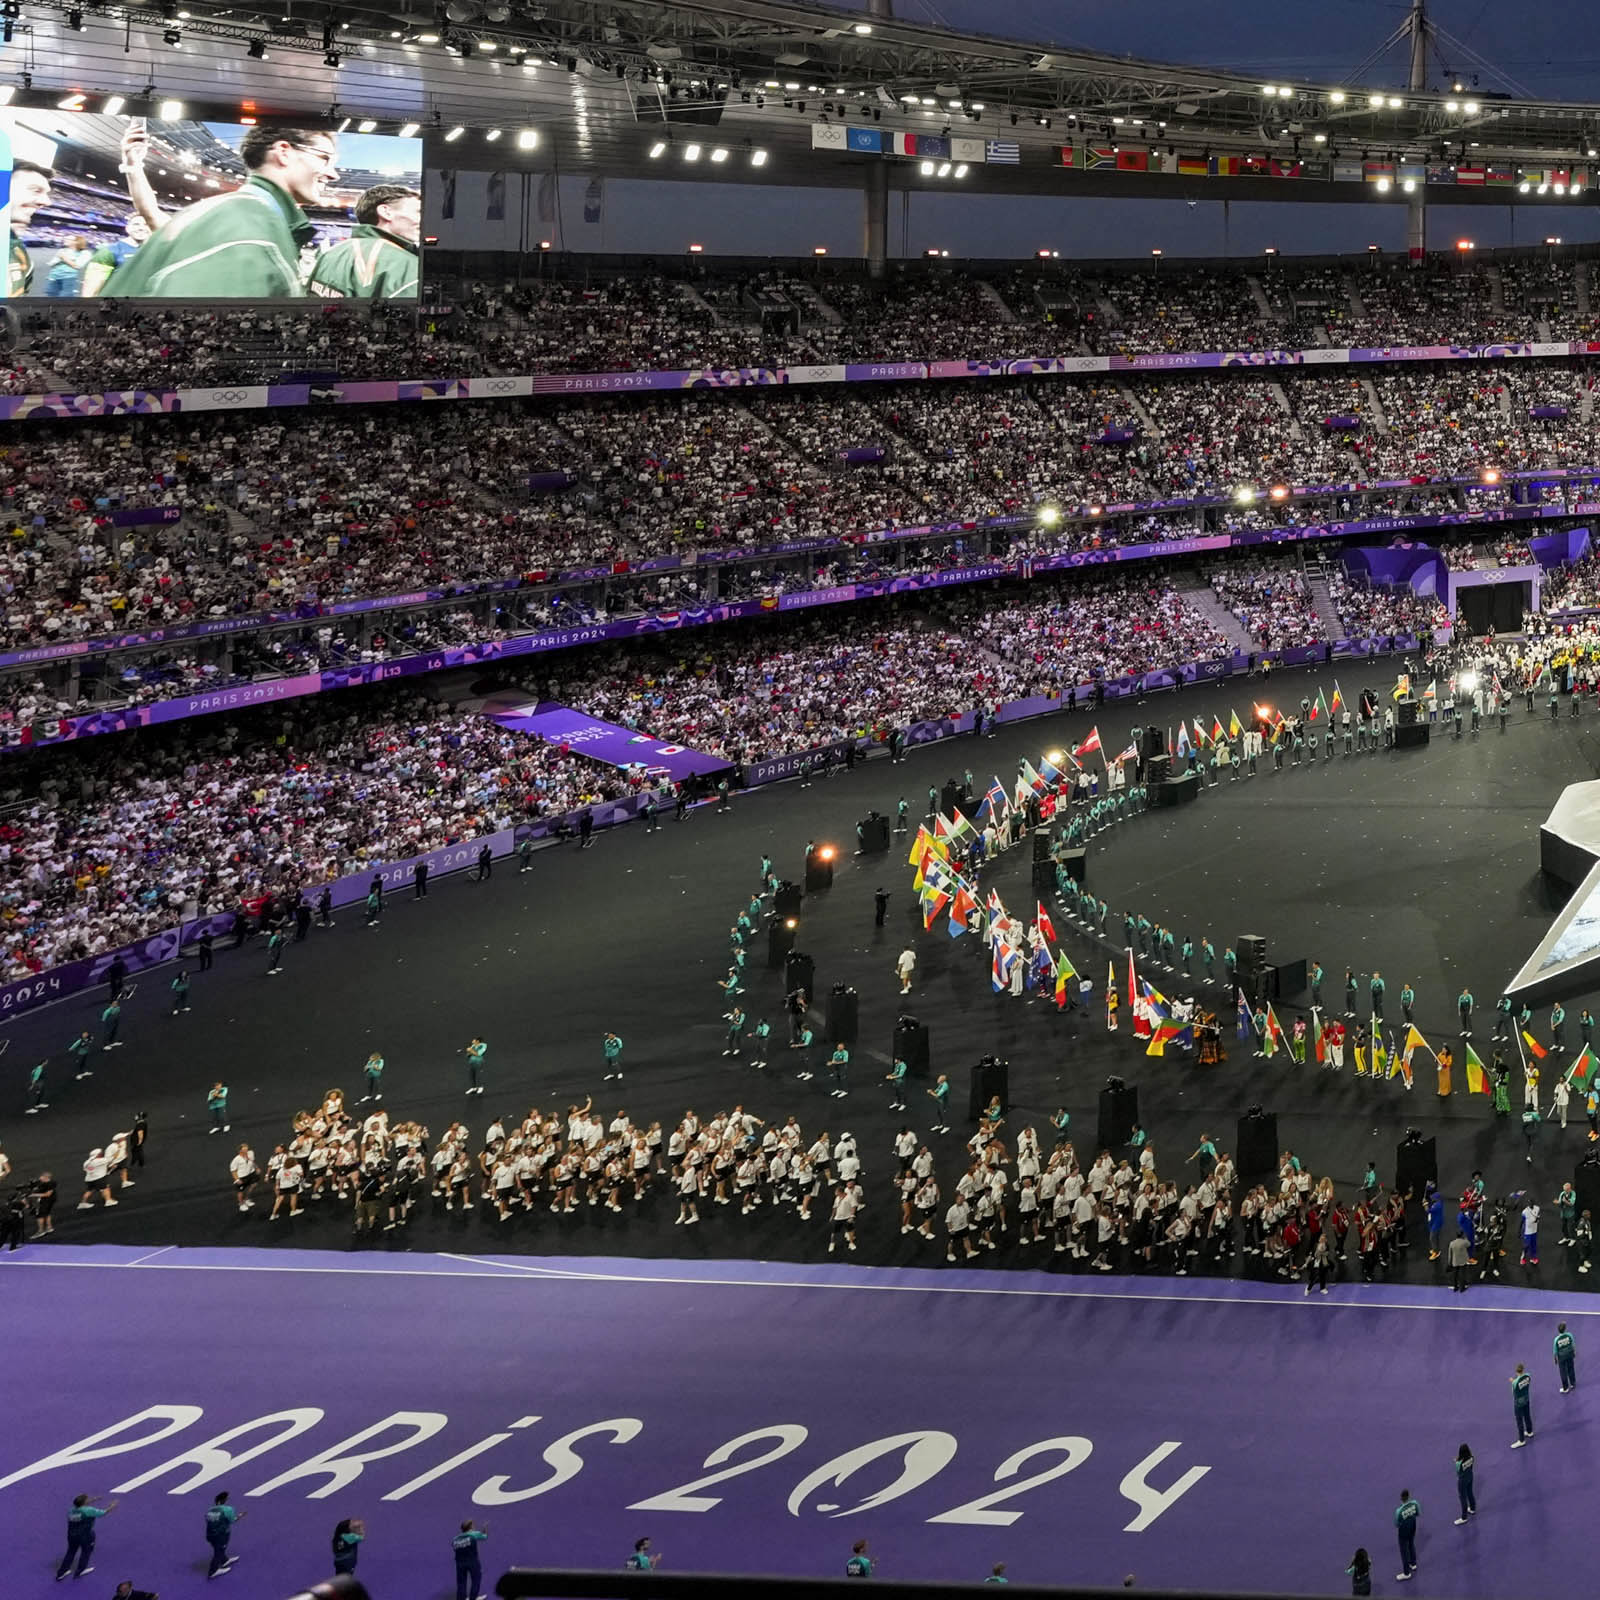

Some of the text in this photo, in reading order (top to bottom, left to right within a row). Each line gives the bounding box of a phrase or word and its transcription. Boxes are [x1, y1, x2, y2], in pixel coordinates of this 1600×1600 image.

[1370, 349, 1429, 358] PAIS 2024
[1133, 356, 1198, 366] PARIS 2024
[871, 366, 942, 376] PARIS 224
[565, 376, 652, 389] PARIS 2024
[1365, 521, 1390, 529] PARIS
[1150, 544, 1175, 553] PARIS
[944, 568, 999, 582] PARIS 2024
[787, 590, 848, 606] PARIS 2024
[208, 617, 261, 631] PARIS 2024
[532, 629, 606, 648] PARIS 2024
[18, 650, 49, 660] PARIS
[384, 659, 441, 677] L13 L6
[190, 684, 284, 711] PARIS 2024
[758, 749, 841, 779] PARIS 204
[380, 846, 482, 882] PARS 202
[2, 977, 60, 1009] 2024
[625, 1423, 1212, 1532] 2024
